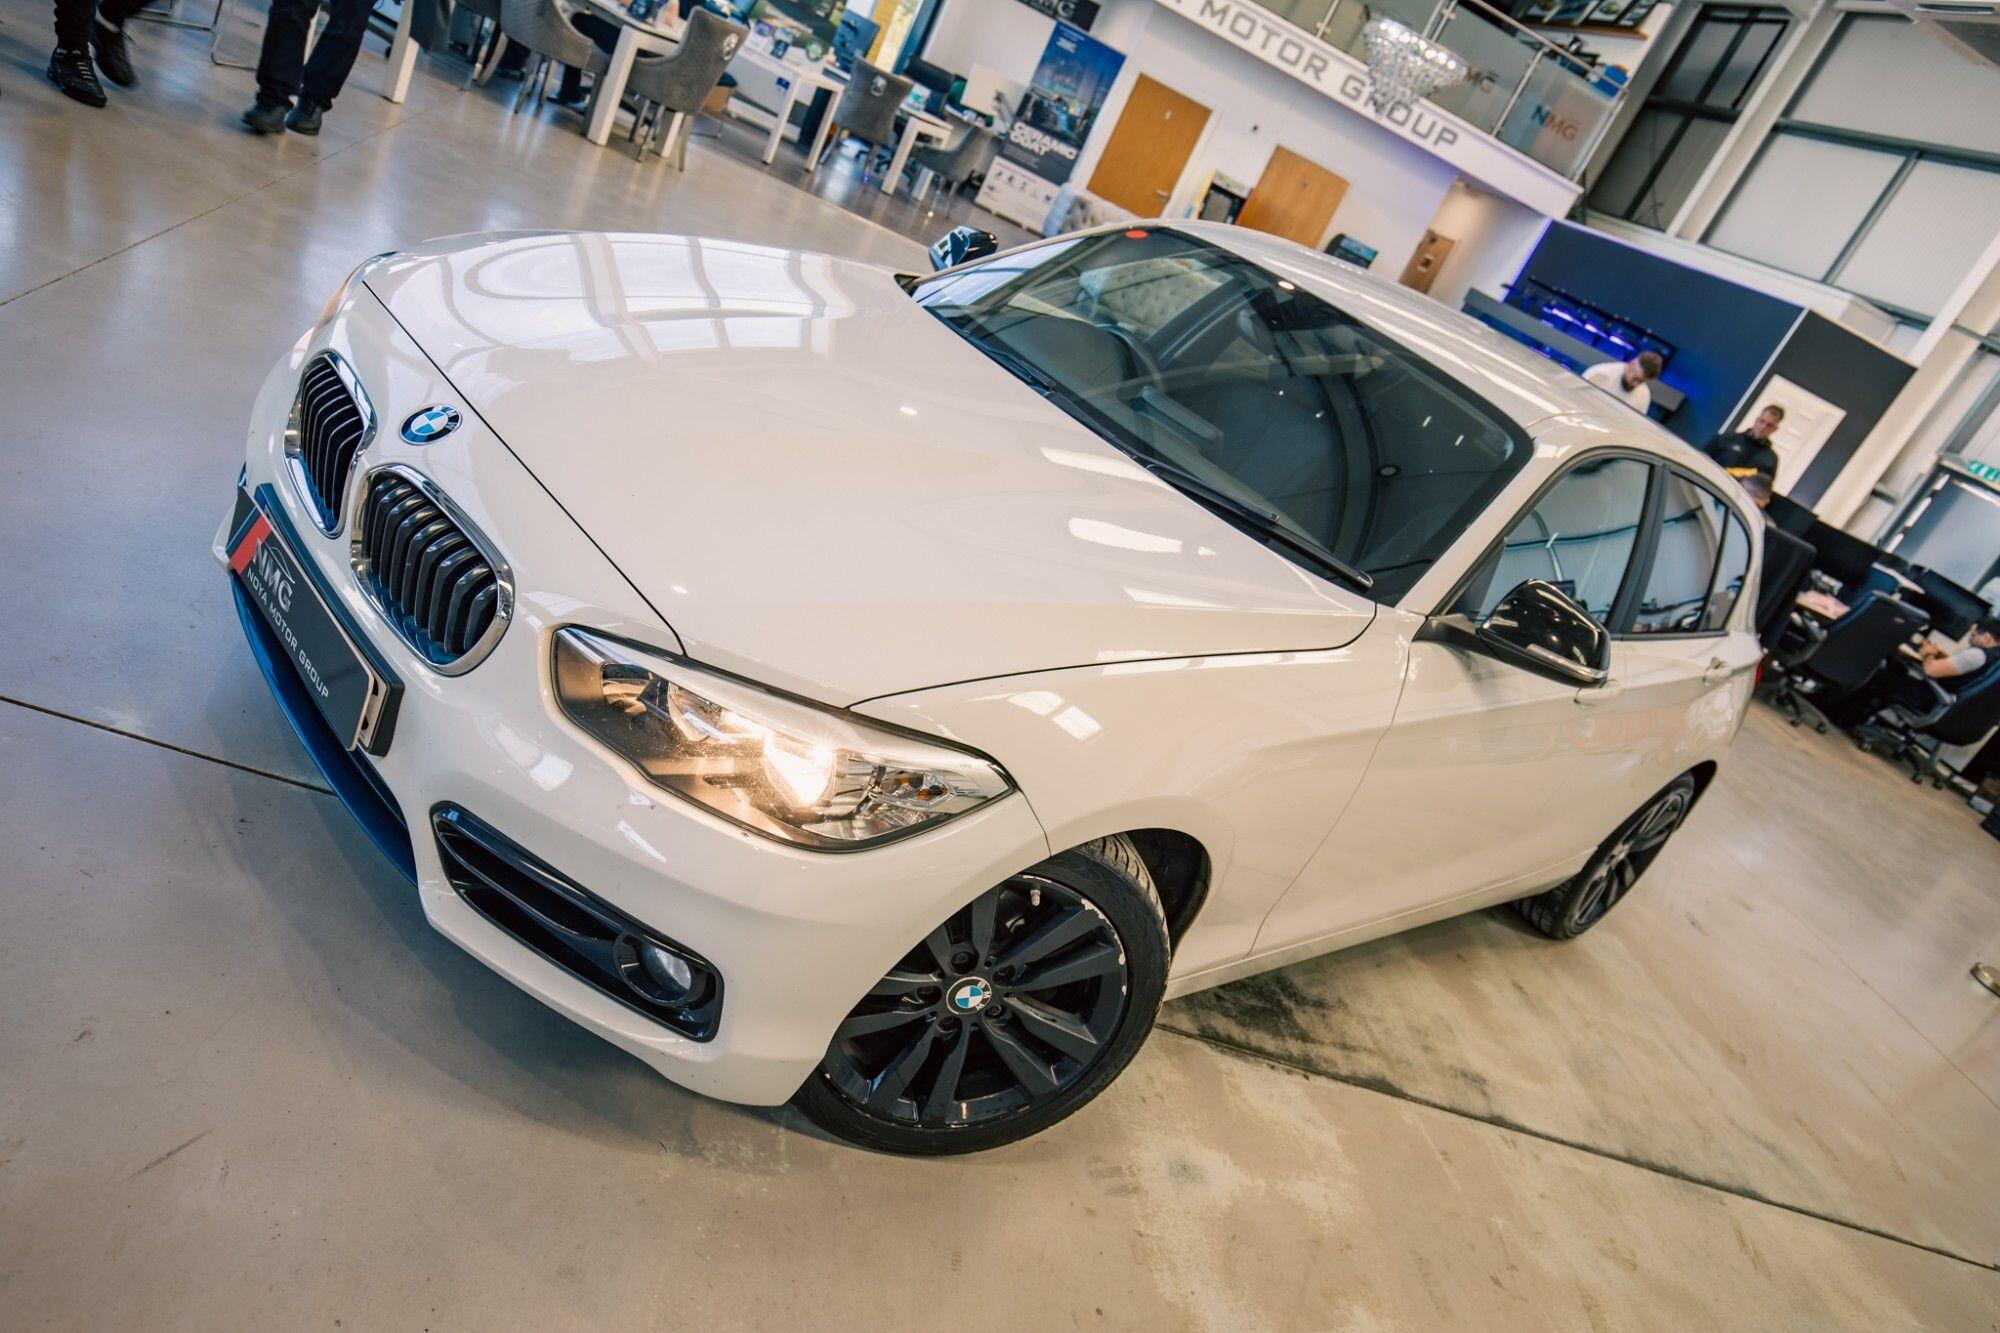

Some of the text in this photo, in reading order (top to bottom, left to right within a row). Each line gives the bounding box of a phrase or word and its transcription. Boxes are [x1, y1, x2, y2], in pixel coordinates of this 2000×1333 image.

[1200, 0, 1329, 81] MOTOR
[1531, 105, 1578, 141] NMG
[252, 537, 293, 612] NMG
[247, 567, 329, 698] NOYA MOTOR GROUP
